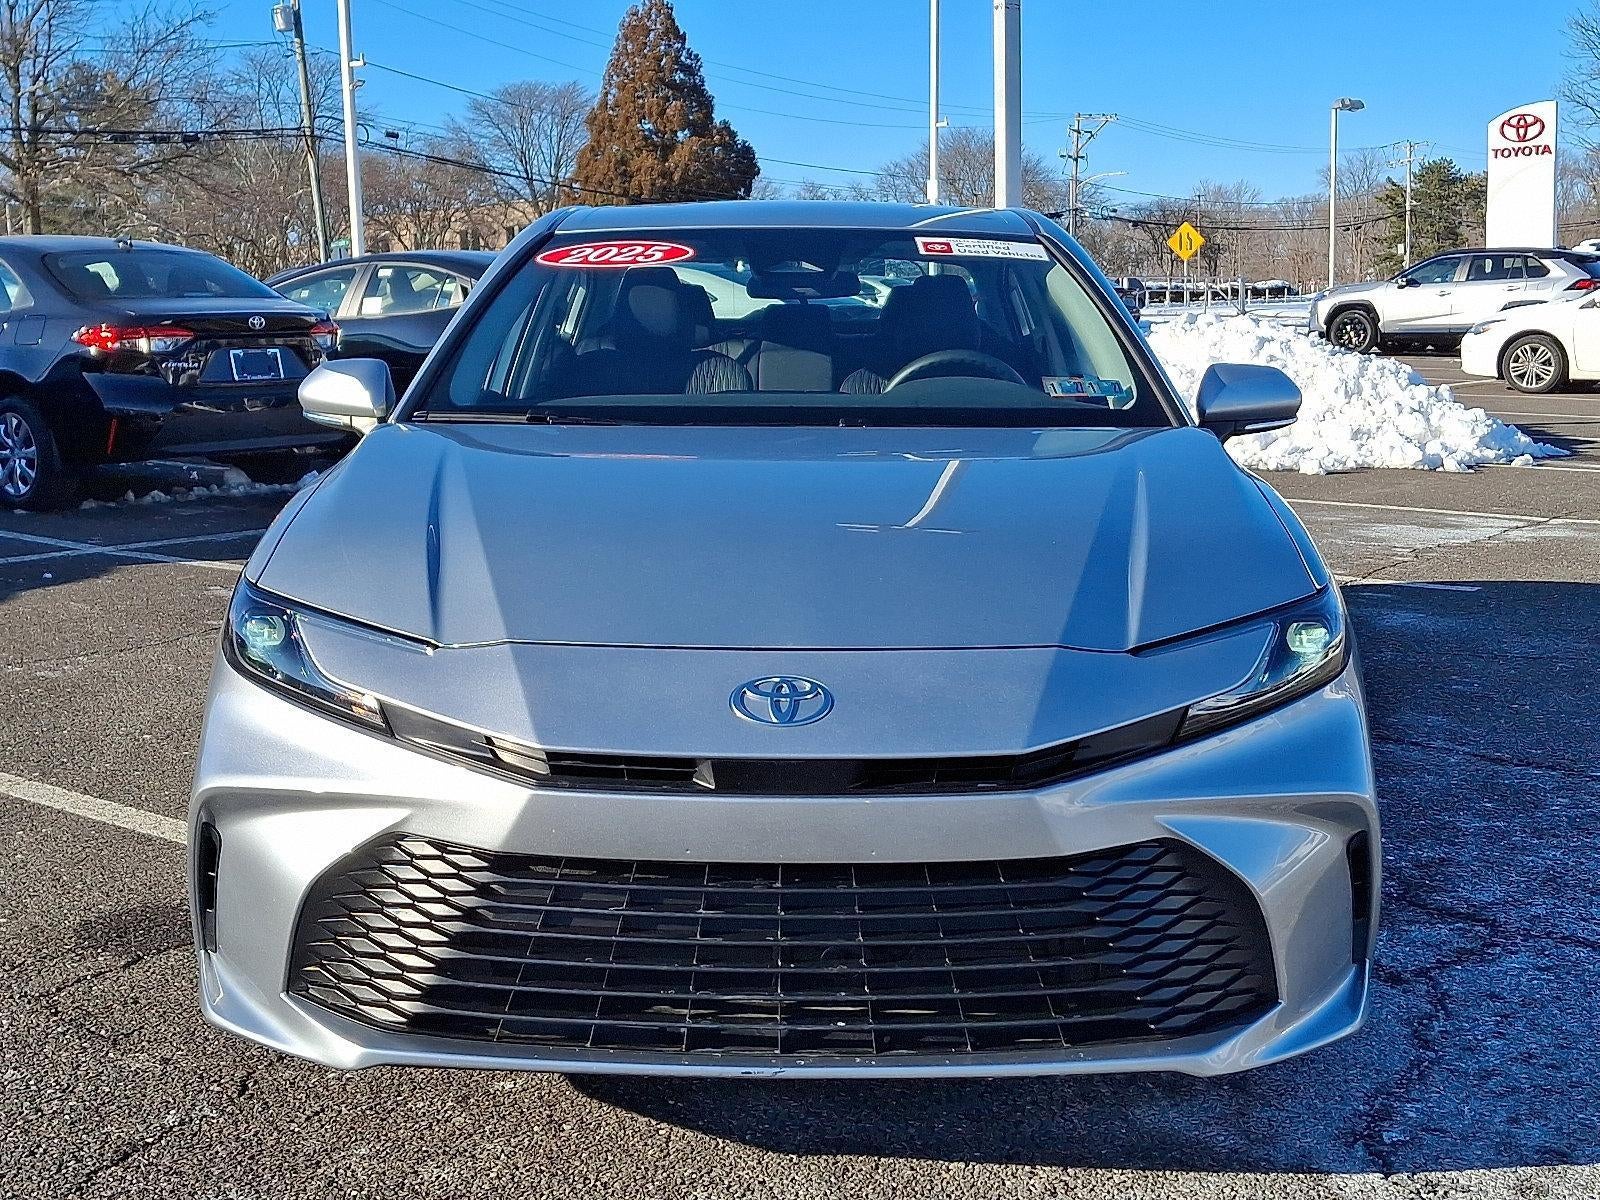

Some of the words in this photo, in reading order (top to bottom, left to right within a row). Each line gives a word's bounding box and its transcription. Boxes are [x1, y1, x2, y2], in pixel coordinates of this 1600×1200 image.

[1491, 144, 1553, 159] TOYOTA
[955, 242, 1011, 251] Certified
[558, 245, 672, 264] 2025
[992, 249, 1044, 259] Vehicles
